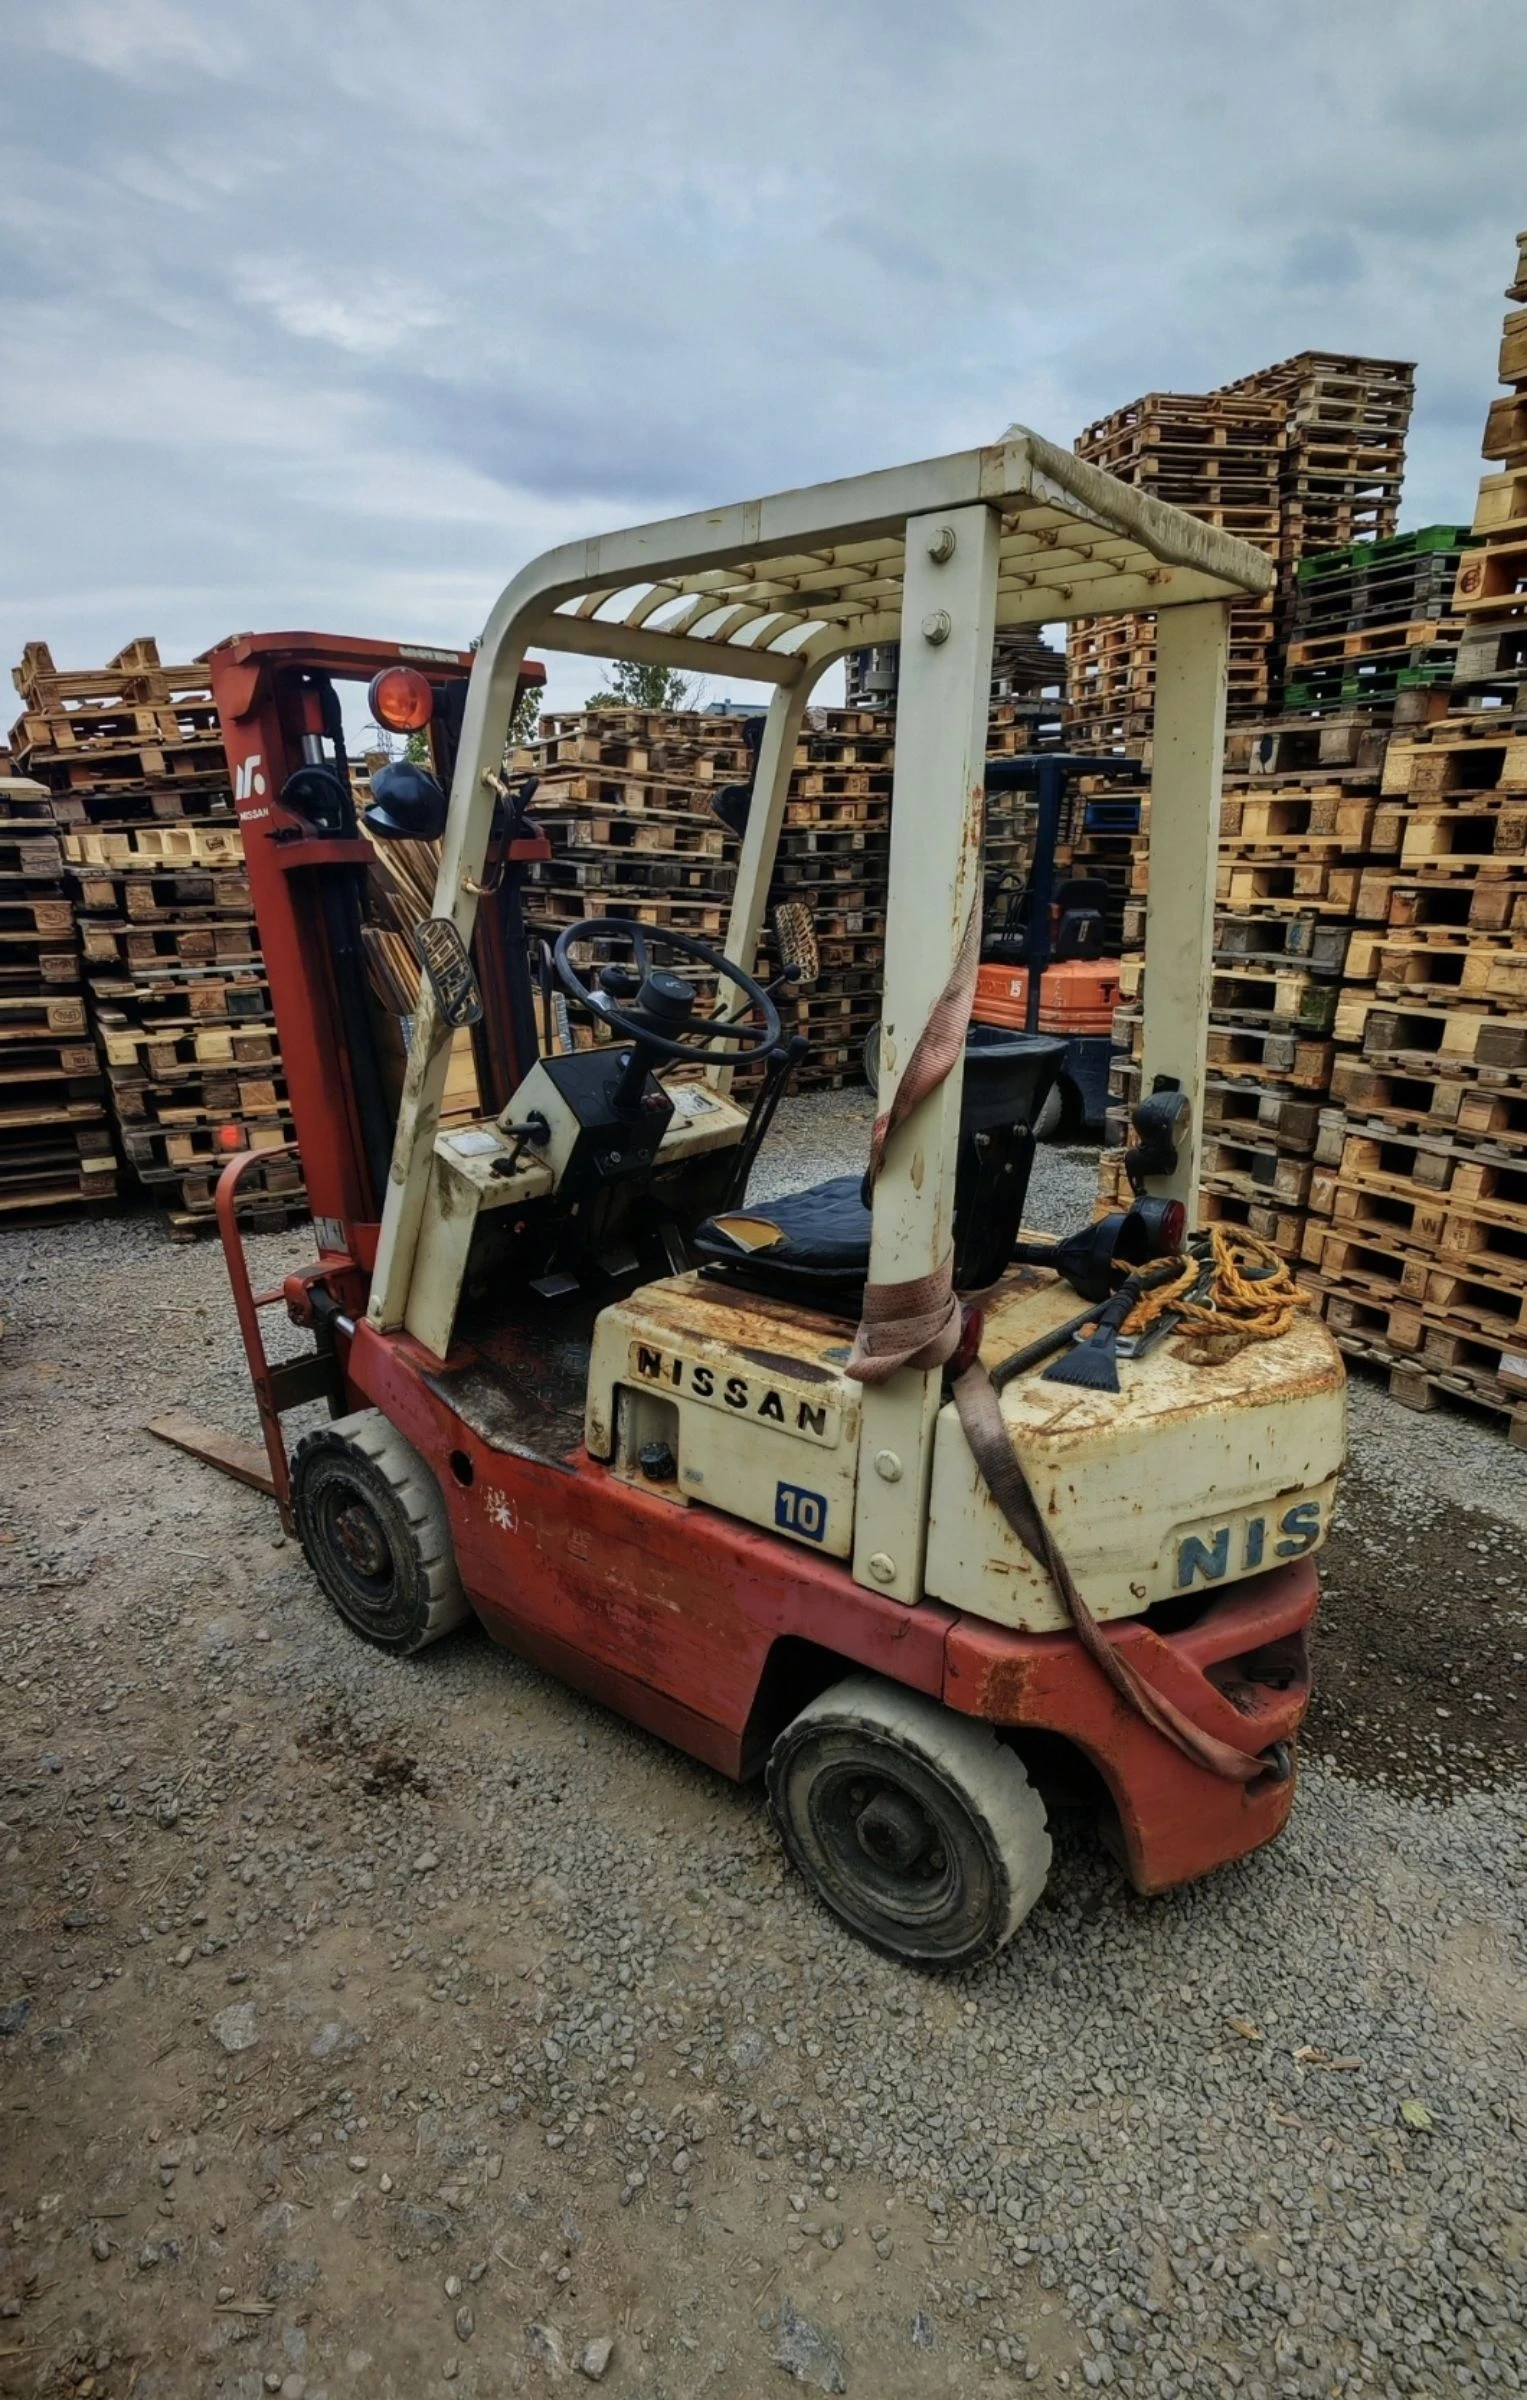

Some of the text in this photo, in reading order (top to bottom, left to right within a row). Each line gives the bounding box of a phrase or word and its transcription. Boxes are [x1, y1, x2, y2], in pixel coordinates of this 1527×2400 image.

[240, 807, 269, 820] NISSAN
[638, 1346, 827, 1437] NISSAN
[780, 1490, 820, 1533] 10
[1176, 1501, 1321, 1588] NIS
